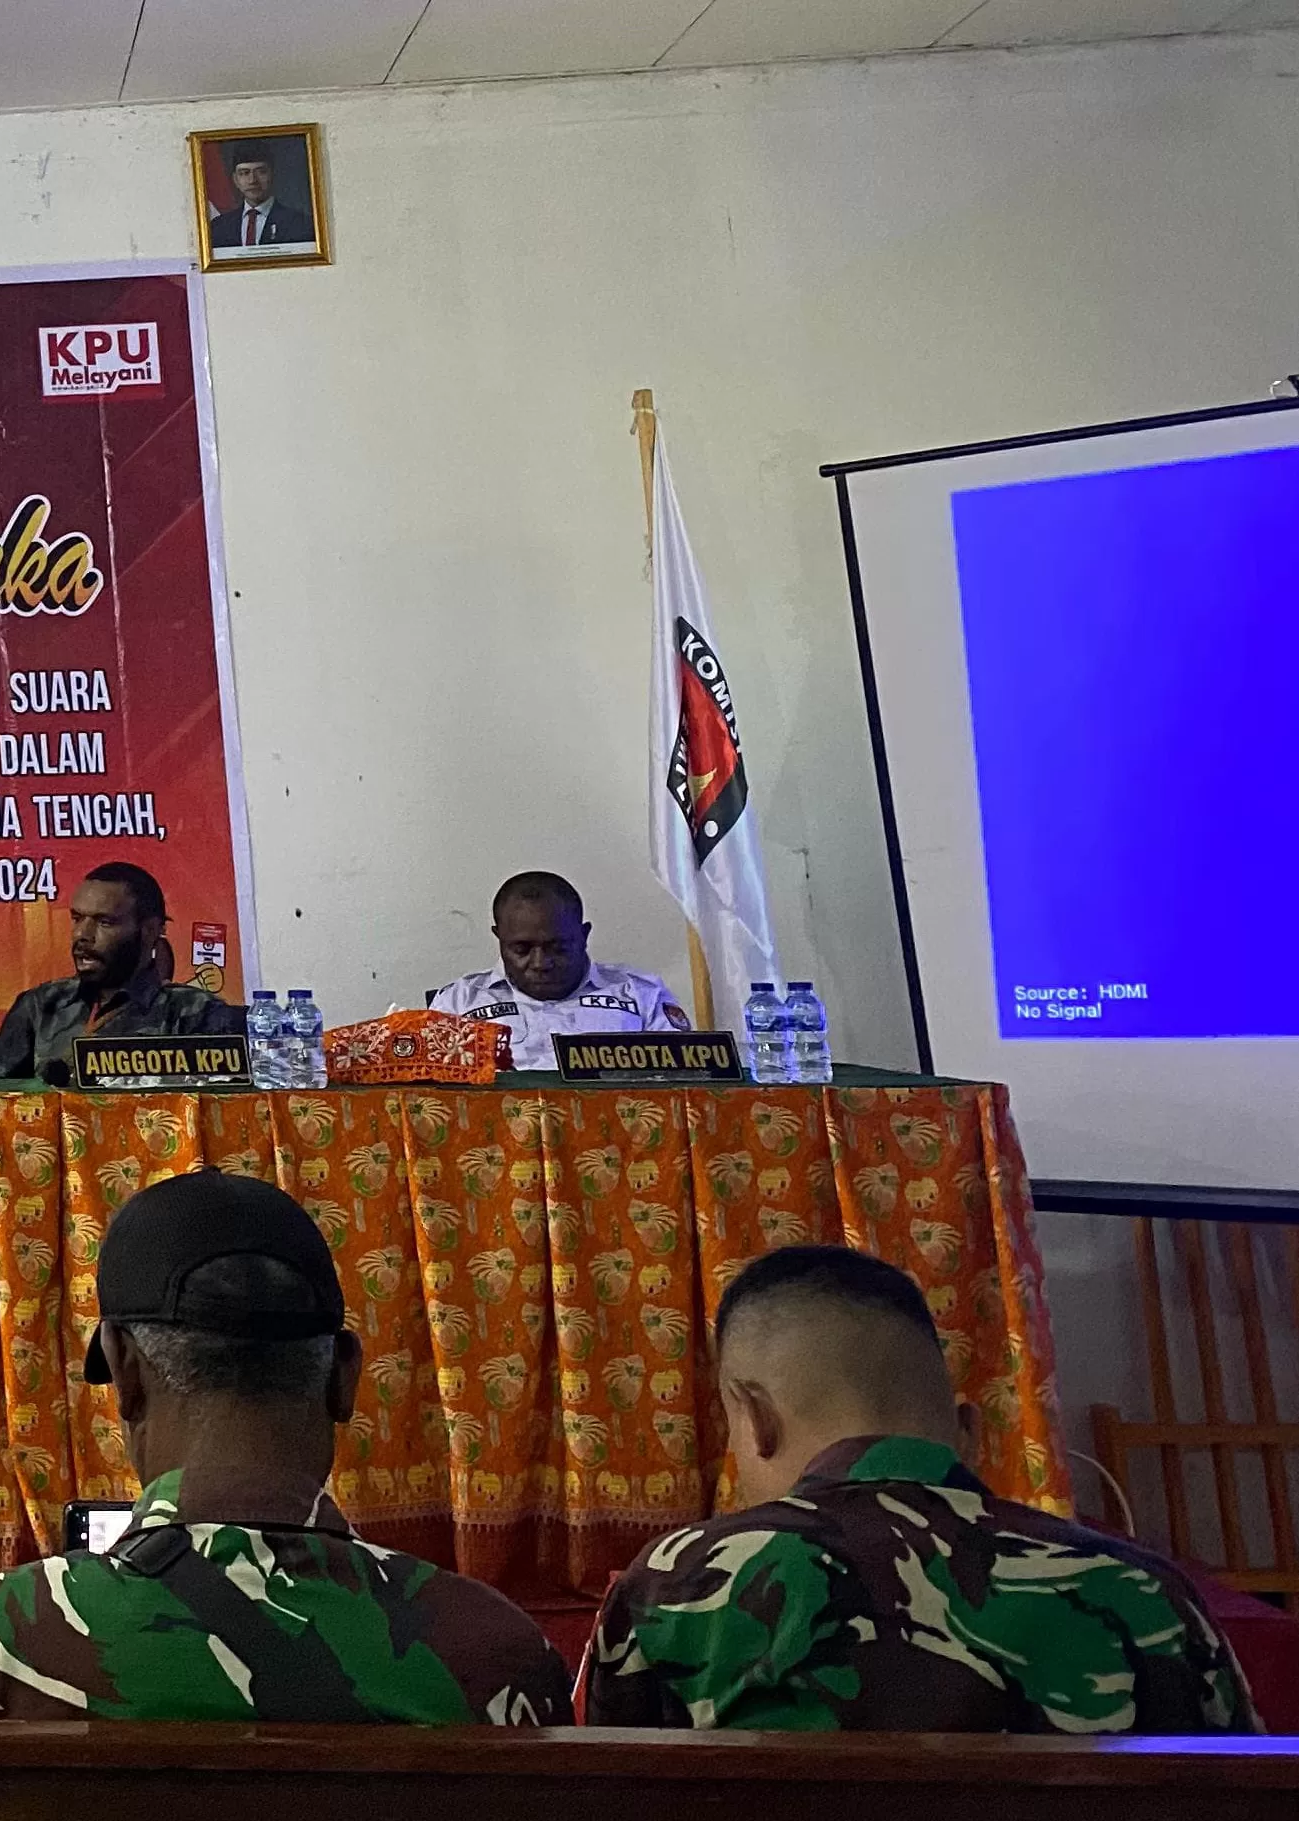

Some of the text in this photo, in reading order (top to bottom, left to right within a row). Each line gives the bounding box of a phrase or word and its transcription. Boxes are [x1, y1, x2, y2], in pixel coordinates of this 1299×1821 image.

[47, 328, 150, 367] KPU
[51, 361, 152, 389] Melayani
[10, 670, 112, 713] SUARA
[0, 732, 105, 776] DALAM
[32, 792, 166, 841] TENGAH,
[1014, 983, 1148, 1001] Source: HDMI
[1016, 1002, 1102, 1021] No Signal
[86, 1048, 241, 1075] ANGGOTA KPU
[568, 1044, 730, 1069] ANGGOTA KPU
